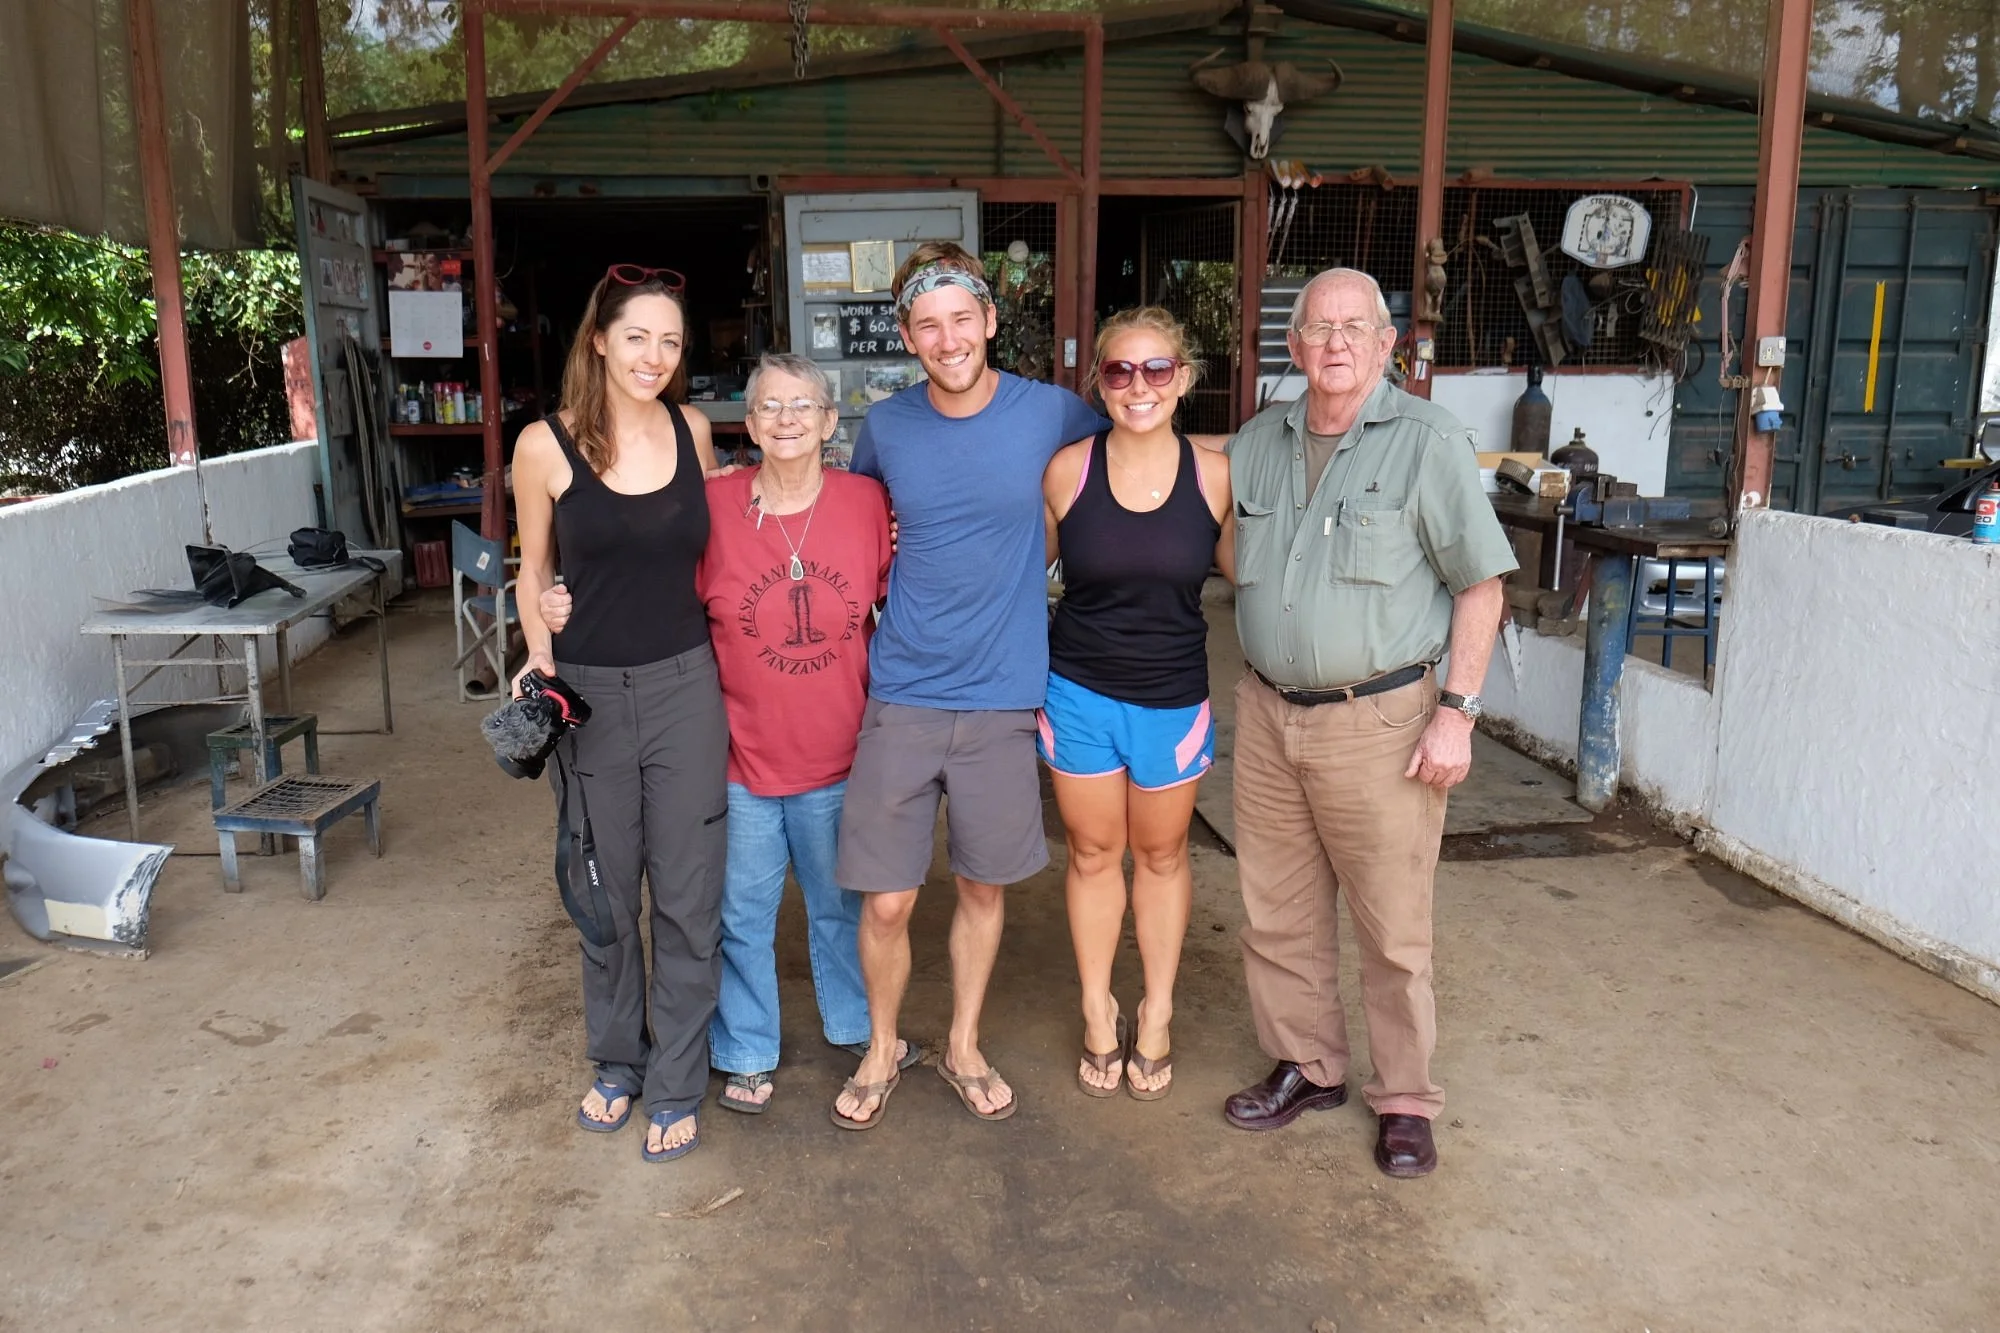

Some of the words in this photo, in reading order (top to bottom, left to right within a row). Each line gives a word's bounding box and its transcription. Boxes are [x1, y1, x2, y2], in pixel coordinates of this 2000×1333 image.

[840, 305, 874, 318] WORK
[880, 305, 897, 316] SH
[849, 318, 861, 336] $
[869, 319, 899, 333] 60.0
[849, 340, 878, 354] PER
[886, 340, 905, 352] DA
[1976, 515, 1992, 524] 20
[738, 564, 787, 639] MESERANI
[800, 560, 852, 593] SNAKE
[588, 859, 599, 886] SONY
